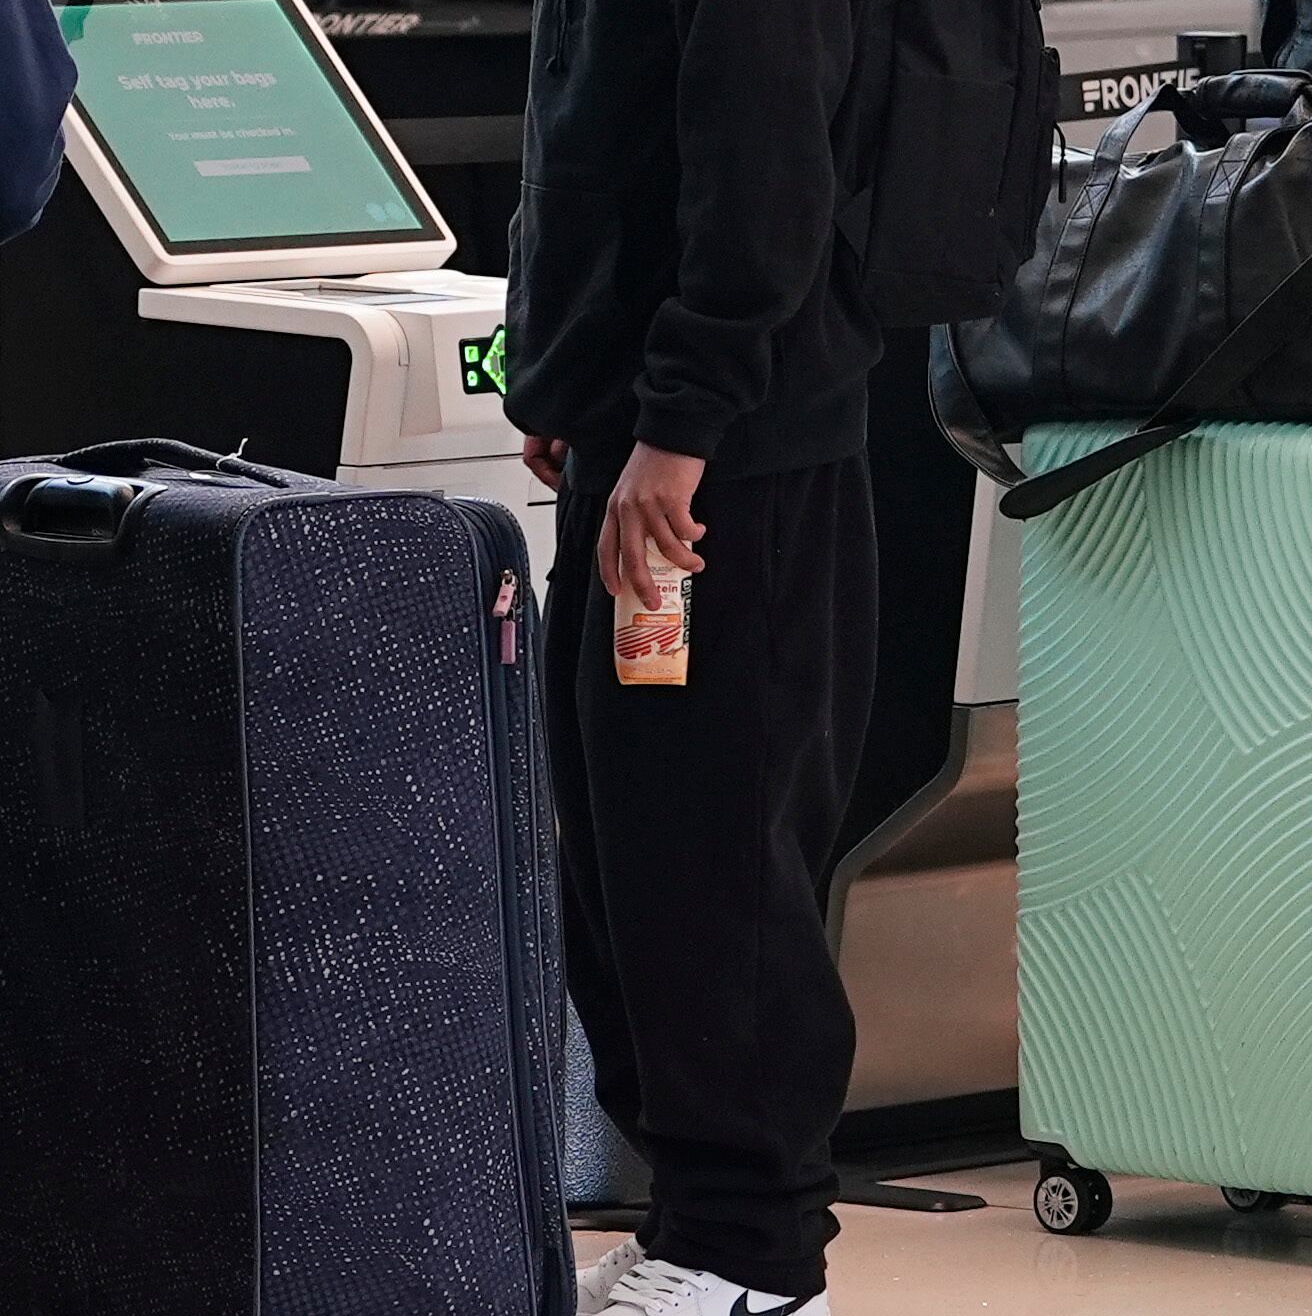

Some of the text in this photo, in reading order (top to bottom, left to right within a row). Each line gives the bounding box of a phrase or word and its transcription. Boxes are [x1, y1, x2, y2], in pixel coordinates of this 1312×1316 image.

[316, 13, 420, 34] ONTIER
[1082, 68, 1201, 112] FRONTIE
[658, 585, 678, 594] tein
